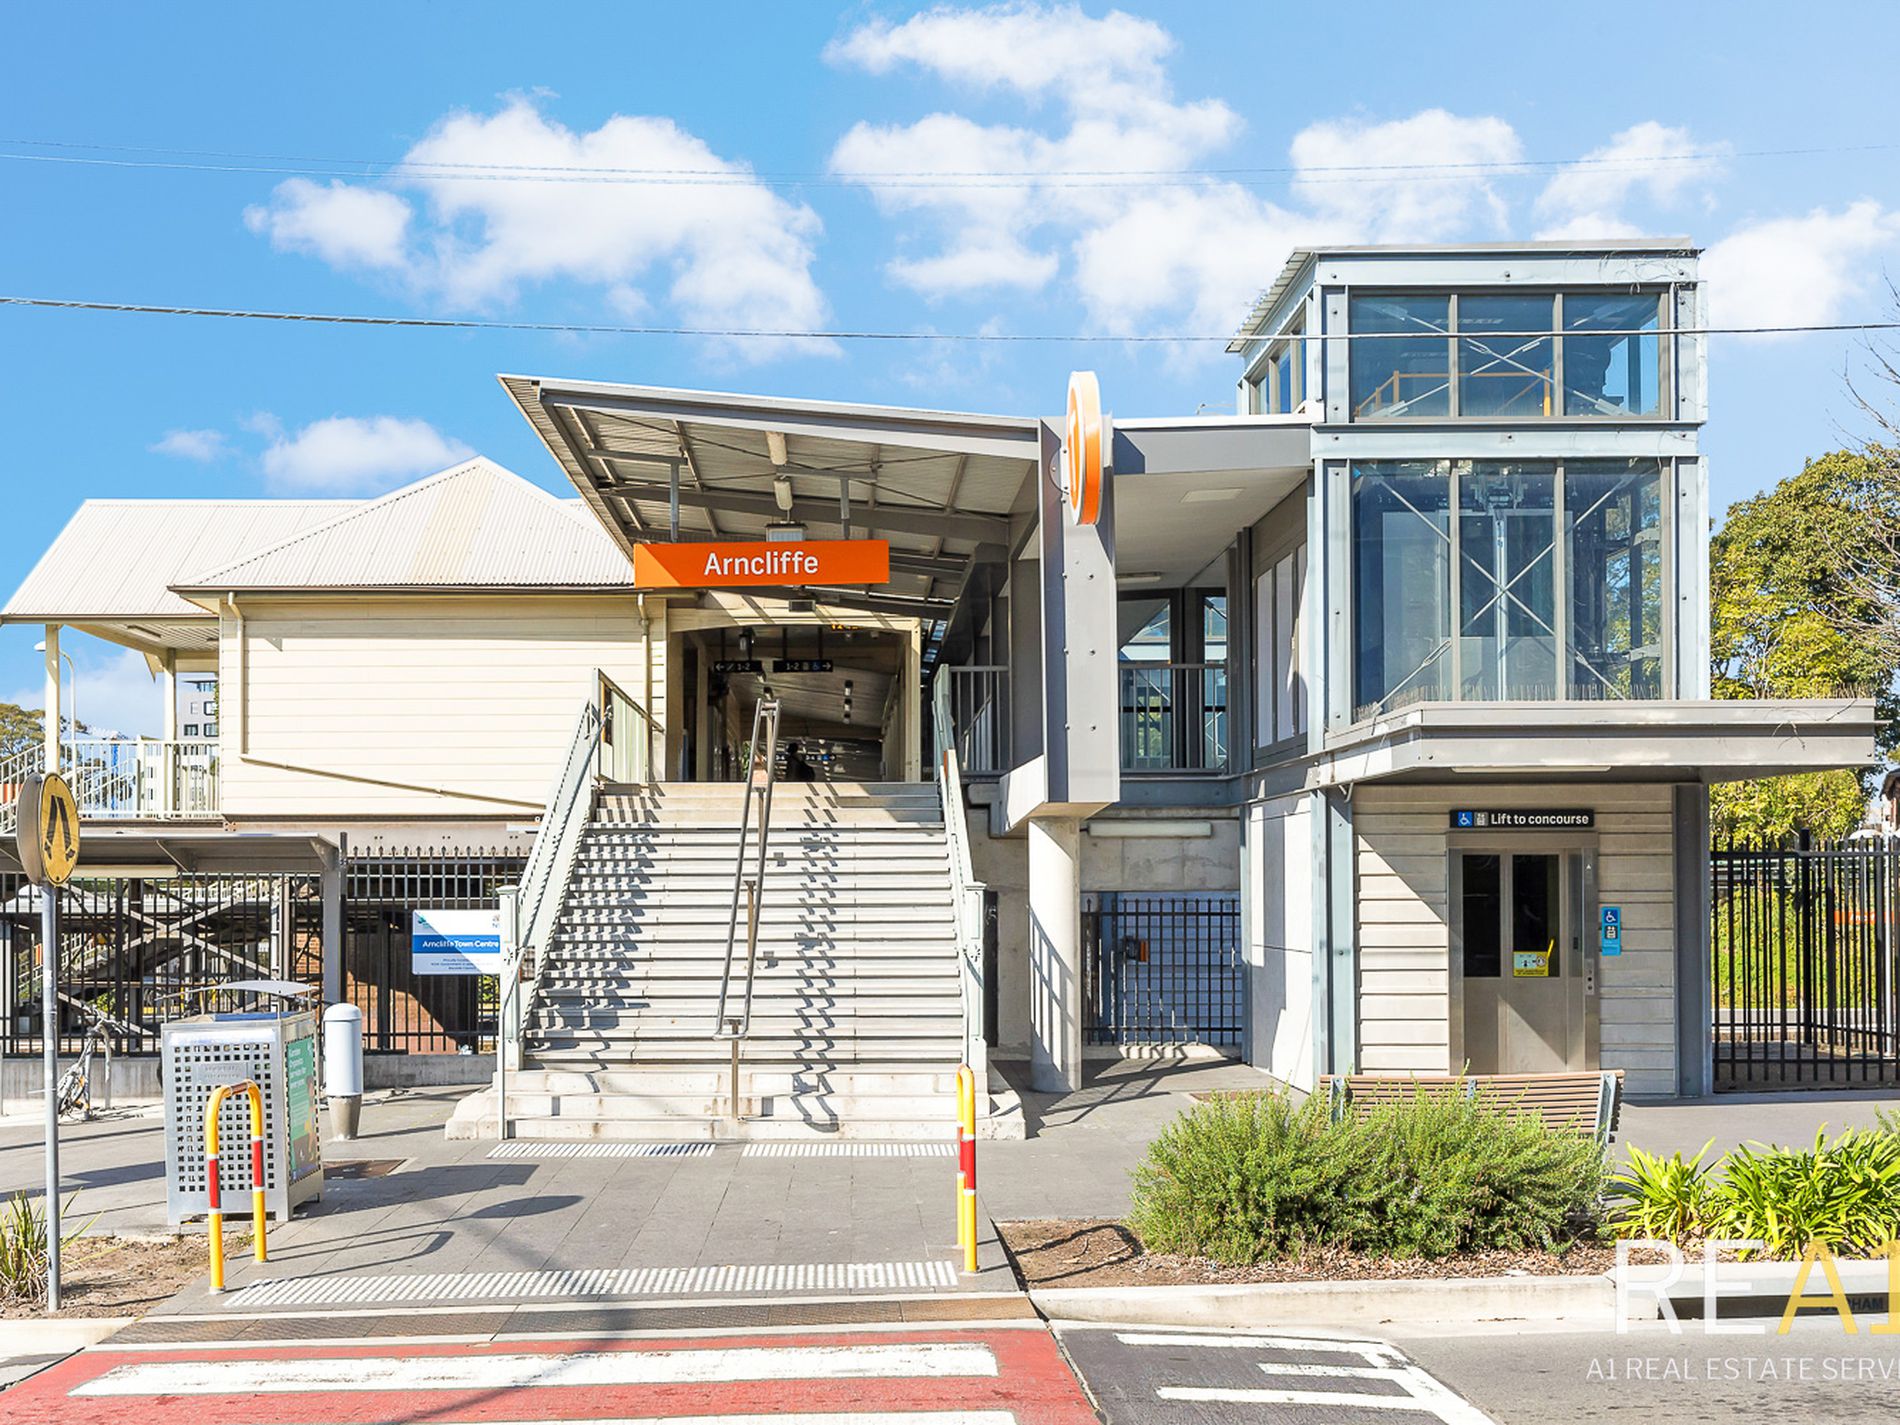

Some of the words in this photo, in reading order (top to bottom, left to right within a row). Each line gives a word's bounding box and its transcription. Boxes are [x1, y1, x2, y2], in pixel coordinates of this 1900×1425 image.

[704, 551, 819, 576] Arncliffe
[737, 662, 751, 671] 1-2
[786, 662, 800, 671] 1-2
[1490, 813, 1512, 825] Lift
[1514, 814, 1526, 825] to
[1528, 815, 1590, 825] concourse
[454, 940, 474, 948] Town
[475, 940, 499, 948] Centre
